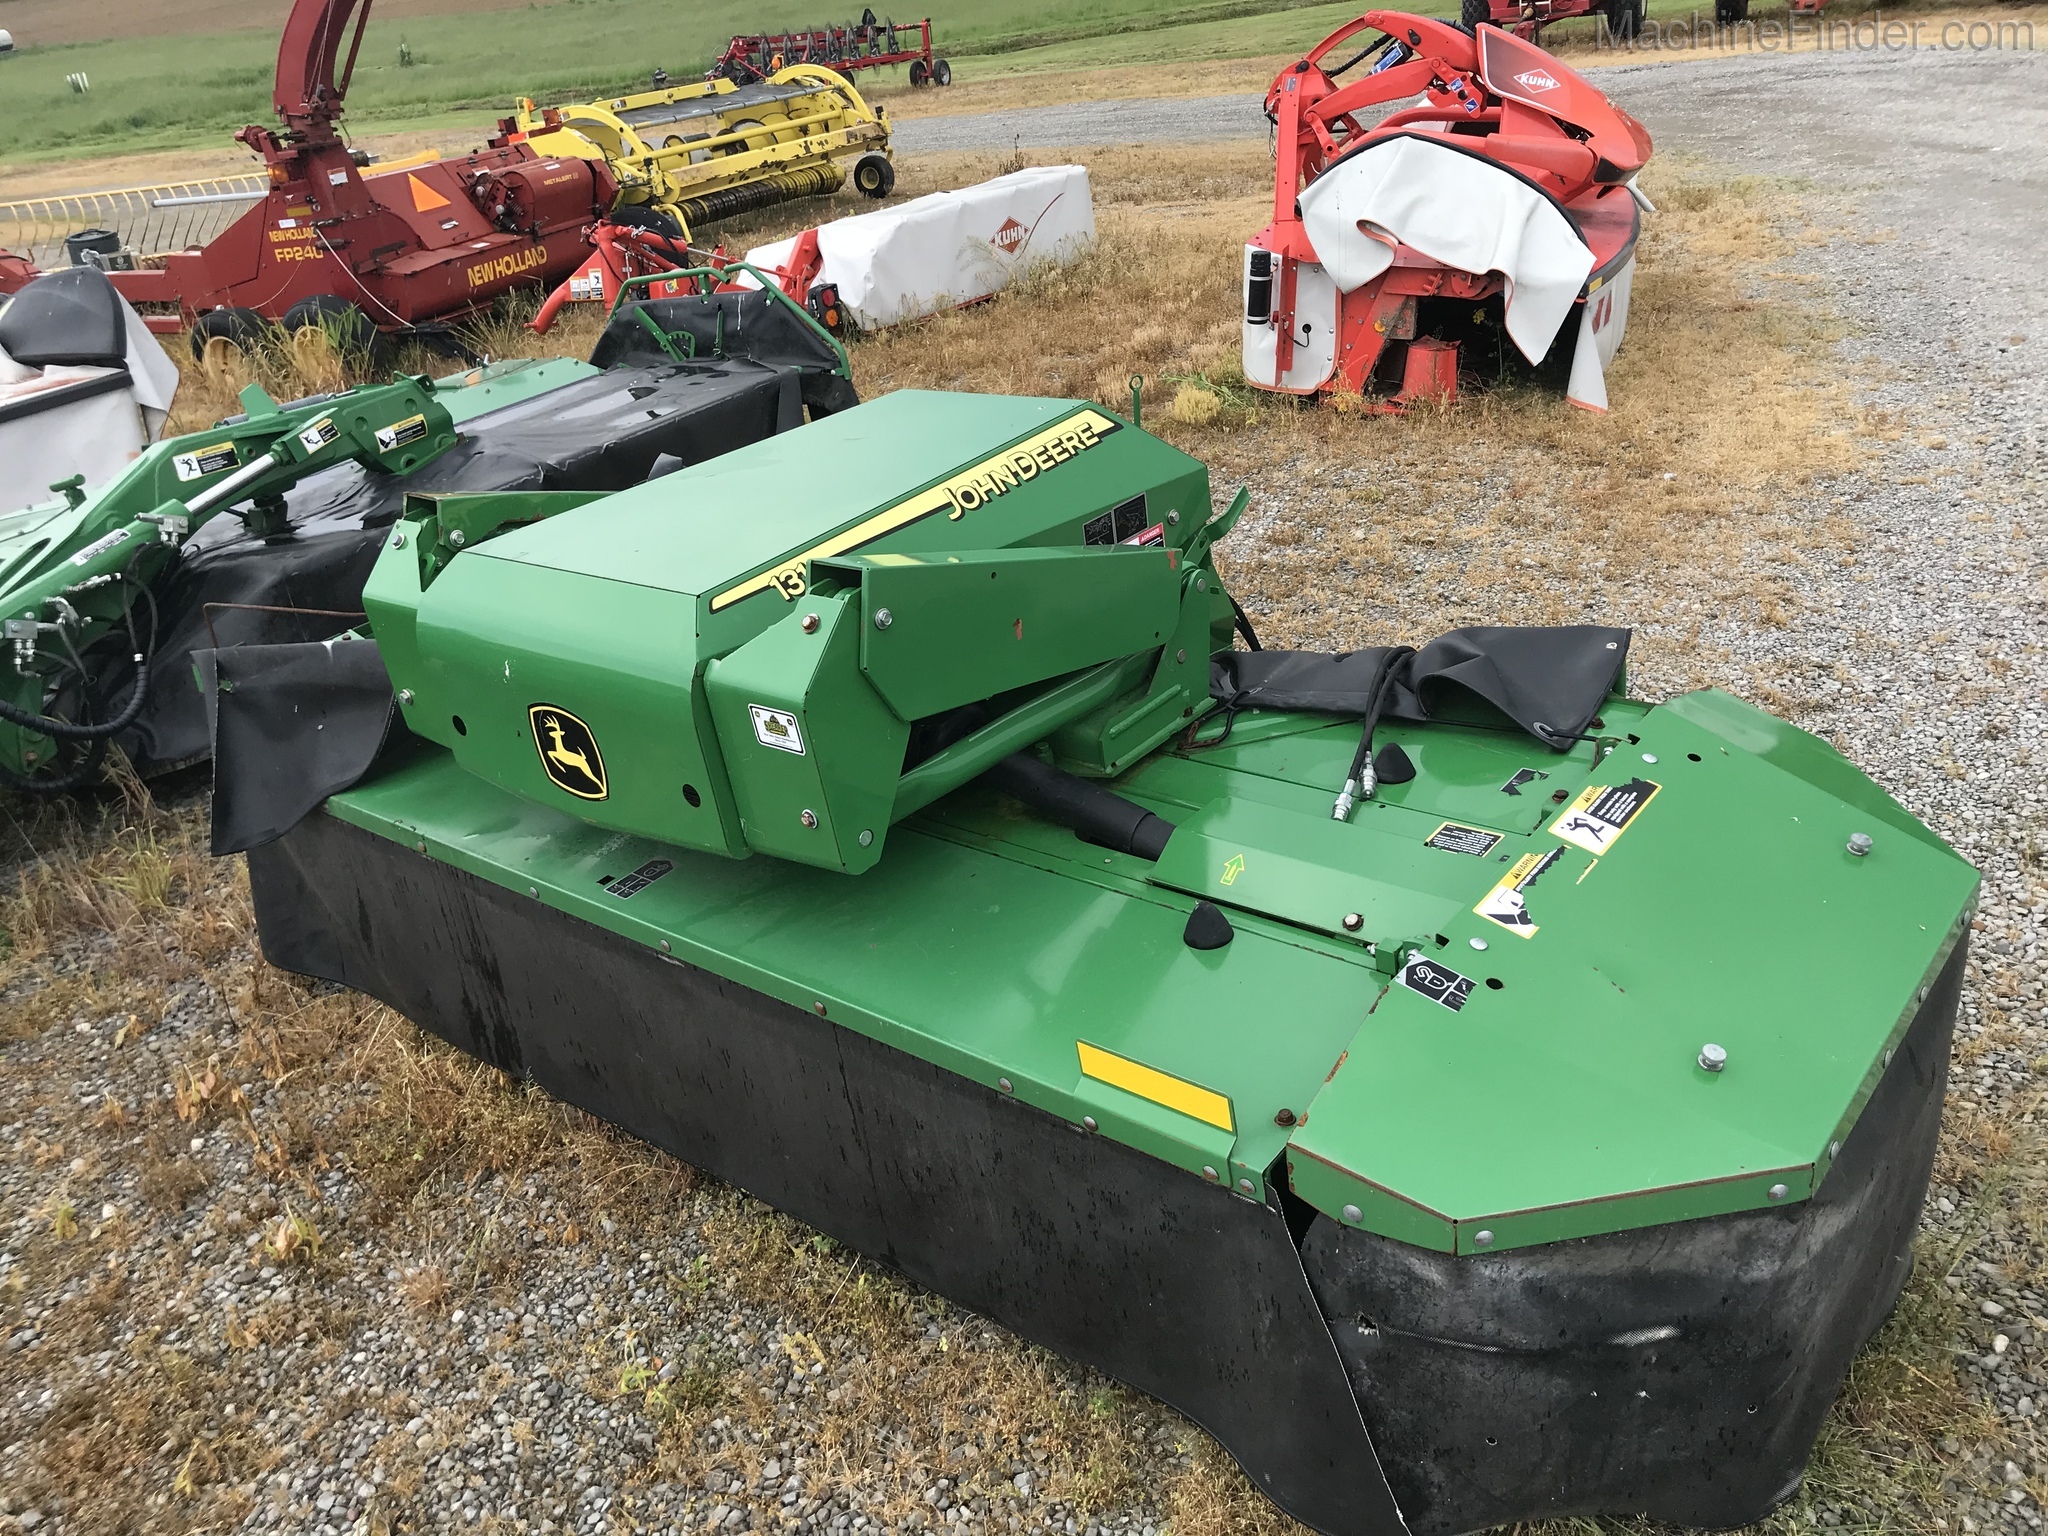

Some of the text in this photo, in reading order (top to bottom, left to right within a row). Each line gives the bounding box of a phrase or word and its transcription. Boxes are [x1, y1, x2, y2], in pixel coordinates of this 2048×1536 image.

[1520, 73, 1555, 88] KUHN
[268, 229, 286, 243] NEW
[994, 225, 1025, 247] KUHN
[467, 245, 548, 288] NEW HOLLAND
[943, 422, 1102, 521] JOHN DEERE
